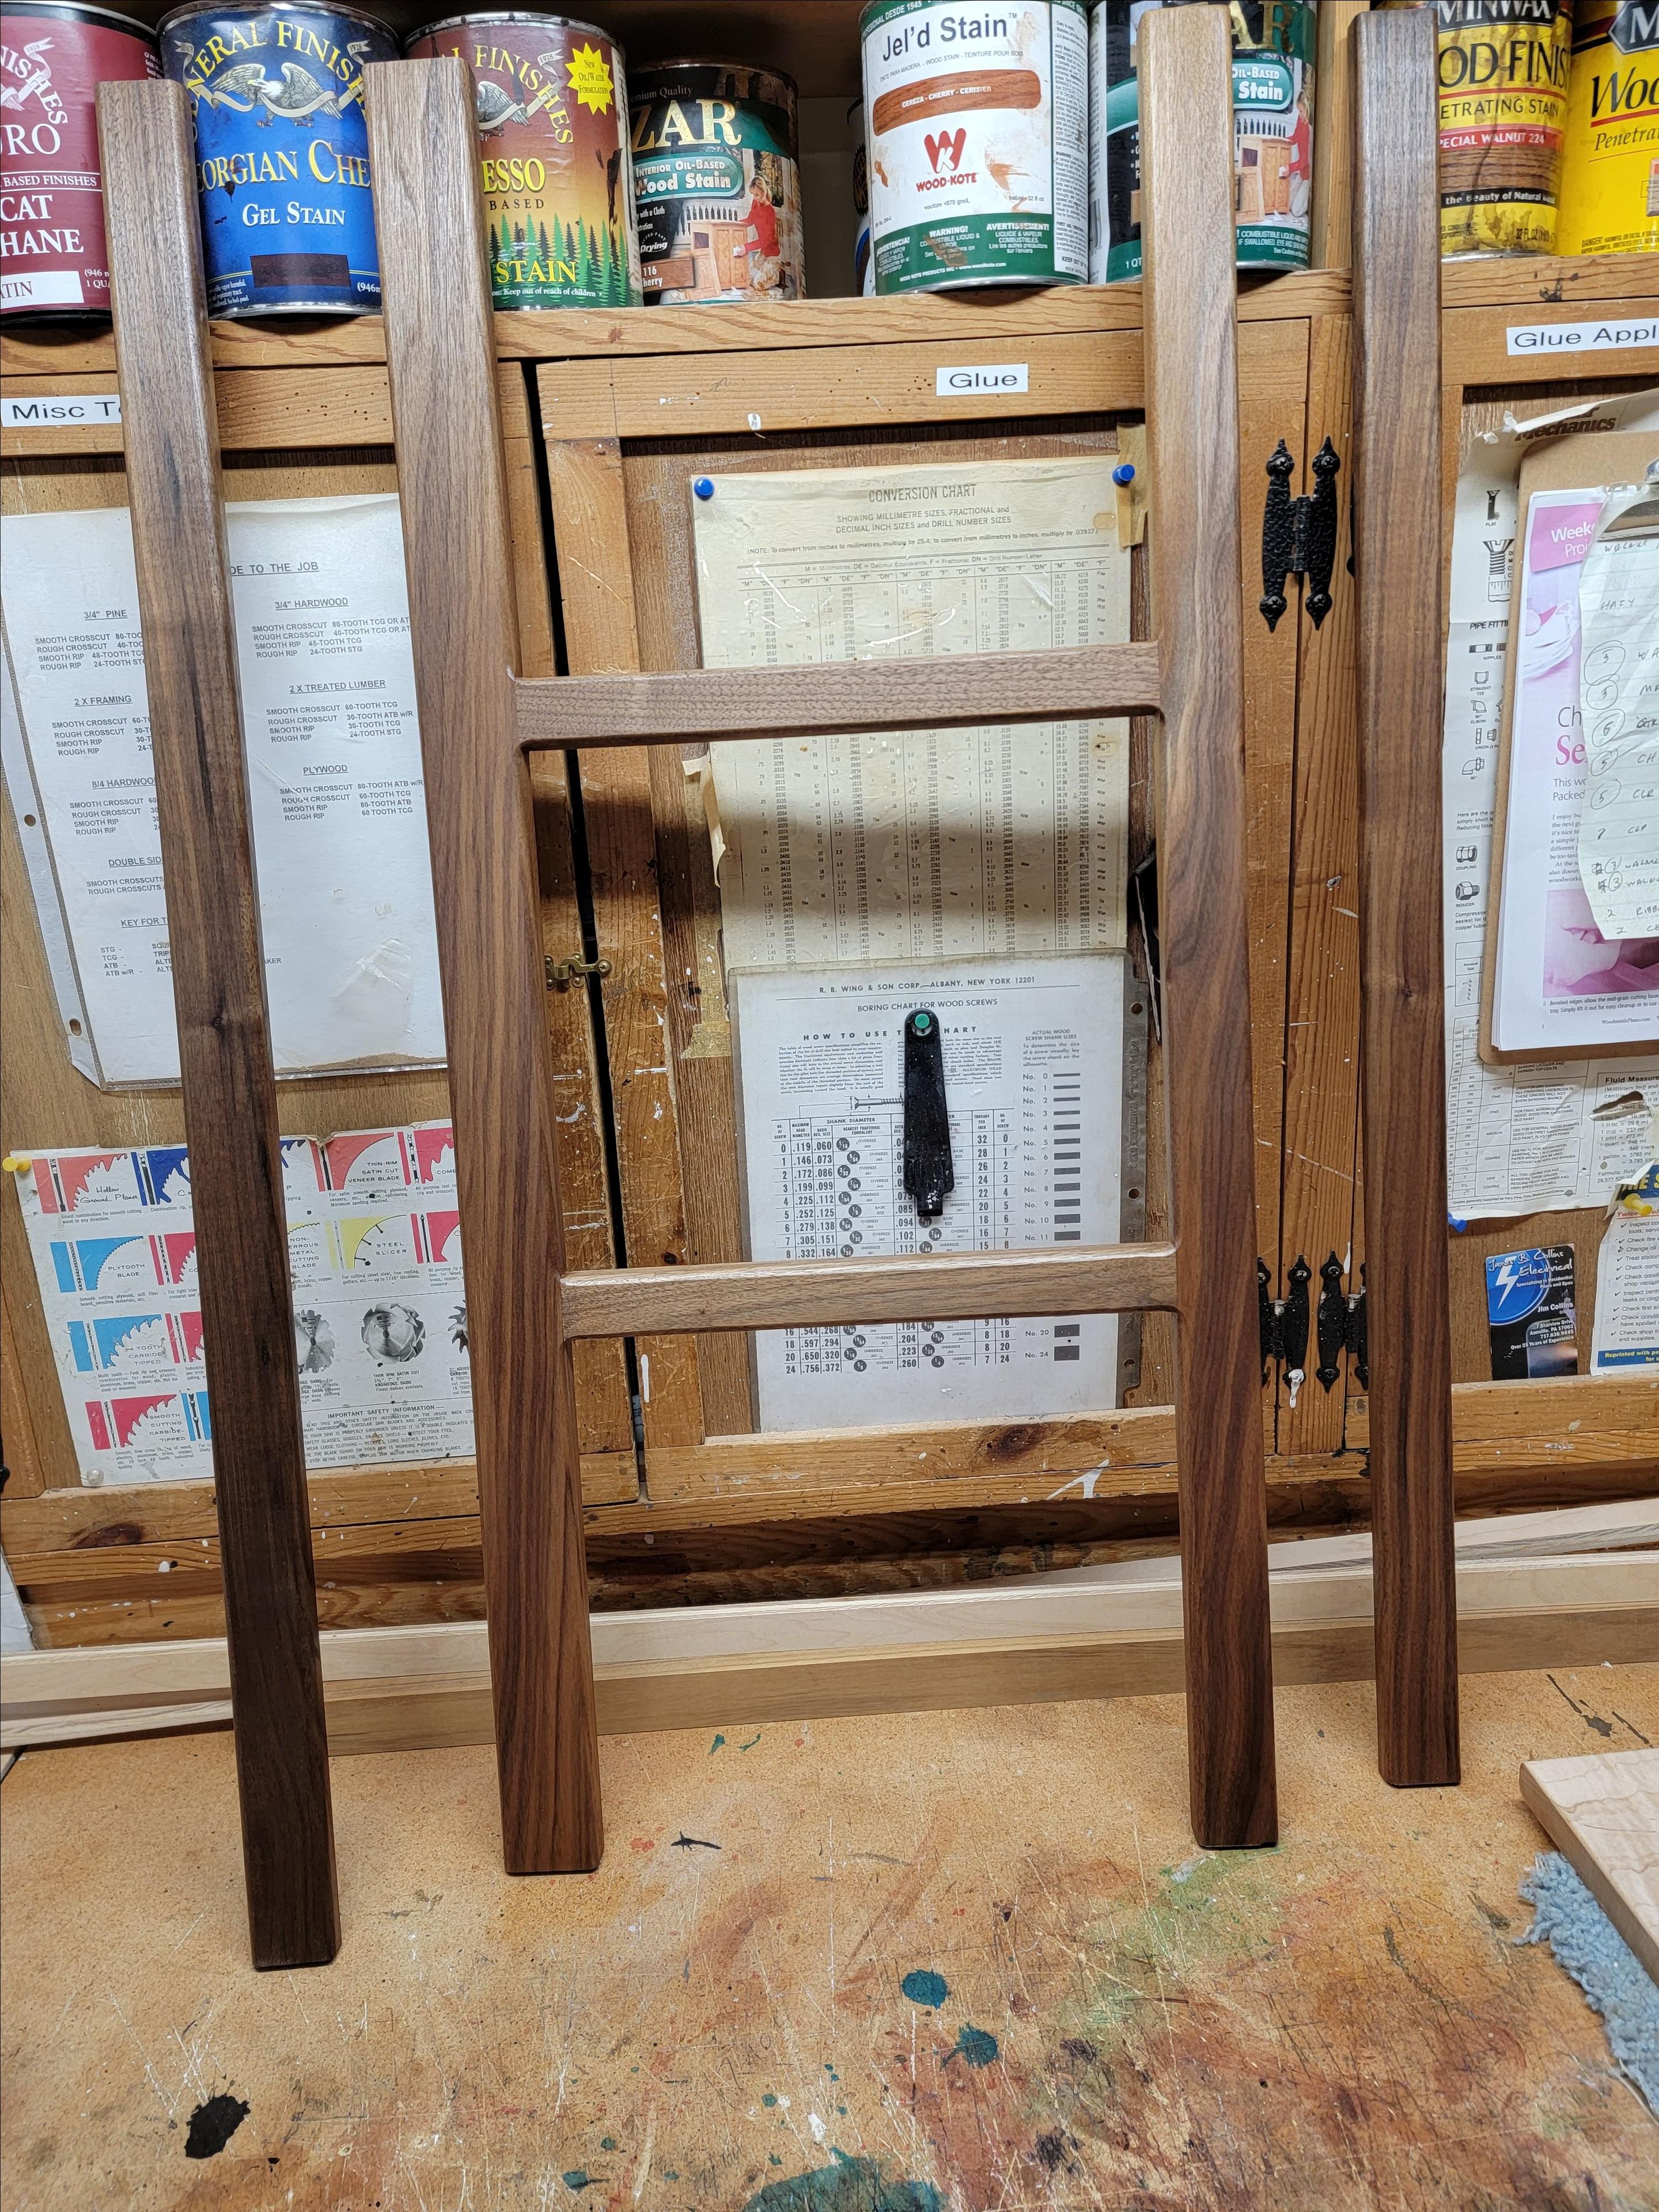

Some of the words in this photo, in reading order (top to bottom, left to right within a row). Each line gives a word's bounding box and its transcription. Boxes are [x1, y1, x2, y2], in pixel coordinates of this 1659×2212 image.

[883, 22, 930, 62] Jel'd
[940, 13, 1007, 42] Stain
[187, 22, 267, 99] NERAL
[926, 56, 942, 66] WOOD
[944, 53, 960, 62] STAIN
[964, 50, 993, 59] TEINTURE
[1508, 40, 1569, 90] FINIS
[475, 45, 574, 144] FINISHES
[660, 85, 693, 99] Quality
[929, 89, 955, 100] CHERRY
[1238, 81, 1283, 100] Stain
[1441, 99, 1523, 120] ETRATING
[1529, 99, 1559, 119] STAIN
[0, 123, 60, 156] RO
[1481, 132, 1526, 145] WALNUT
[1529, 132, 1544, 144] 224
[4, 176, 40, 187] BASED
[42, 175, 97, 187] FINISHES
[481, 157, 546, 194] ESSO
[685, 171, 731, 189] Stain
[488, 199, 544, 211] BASED
[1445, 196, 1463, 205] the
[1502, 192, 1512, 200] of
[1514, 192, 1541, 200] Natural
[0, 194, 52, 222] CAT
[243, 203, 281, 226] GEL
[287, 202, 346, 225] STAIN
[929, 225, 968, 237] WARNING!
[987, 223, 1050, 231] AVERTISSEMENT!
[0, 229, 84, 257] HANE
[640, 241, 668, 254] Drying
[85, 268, 102, 278] (946
[495, 259, 576, 284] STAIN
[643, 266, 657, 277] 116
[642, 277, 662, 287] herry
[503, 287, 521, 298] Keep
[535, 287, 543, 295] of
[544, 287, 562, 296] reach
[563, 287, 570, 296] of
[571, 287, 596, 297] children
[1514, 331, 1581, 347] Glue
[949, 373, 1018, 388] Glue
[12, 404, 85, 419] Misc
[869, 485, 938, 502] CONVERSION
[941, 483, 977, 499] CHART
[837, 513, 874, 522] SHOWING
[876, 510, 922, 521] MILLIMETRE
[949, 506, 995, 517] FRACTIONAL
[836, 525, 869, 534] DECIMAL
[872, 523, 891, 532] INCH
[893, 521, 915, 531] SIZES
[931, 518, 954, 527] DRILL
[956, 517, 989, 527] NUMBER
[249, 564, 264, 574] TO
[270, 563, 291, 573] THE
[297, 562, 319, 571] JOB
[294, 597, 349, 608] HARDWOOD
[106, 609, 127, 618] PINE
[252, 623, 285, 632] SMOOTH
[286, 622, 328, 631] CROSSCUT
[332, 619, 368, 628] 80-TOOTH
[369, 618, 385, 626] TCG
[1469, 622, 1486, 630] PIPE
[304, 682, 346, 692] TREATED
[348, 679, 386, 690] LUMBER
[90, 695, 132, 705] FRAMING
[1558, 705, 1581, 728] Ch
[302, 764, 348, 775] PLYWOOD
[1553, 778, 1571, 787] This
[1553, 791, 1585, 801] Packed
[108, 857, 145, 867] DOUBLE
[841, 984, 863, 993] WING
[968, 978, 986, 986] NEW
[990, 977, 1010, 985] YORK
[857, 1003, 889, 1012] BORING
[891, 1001, 918, 1011] CHART
[920, 1001, 935, 1009] FOR
[937, 999, 964, 1008] WOOD
[966, 998, 998, 1007] SCREWS
[804, 1033, 831, 1041] HOW
[865, 1029, 888, 1037] USE
[944, 1025, 978, 1033] HART
[793, 1142, 810, 1152] .119
[814, 1141, 832, 1151] .060
[977, 1134, 987, 1144] 32
[1534, 1248, 1565, 1261] Collins
[1519, 1258, 1573, 1277] Electrical
[1537, 1304, 1549, 1313] Jim
[1550, 1302, 1573, 1310] Collins
[1548, 1335, 1574, 1343] Experience
[327, 1411, 363, 1419] IMPORTANT
[367, 1408, 389, 1416] SAFETY
[393, 1404, 435, 1413] INFORMATION
